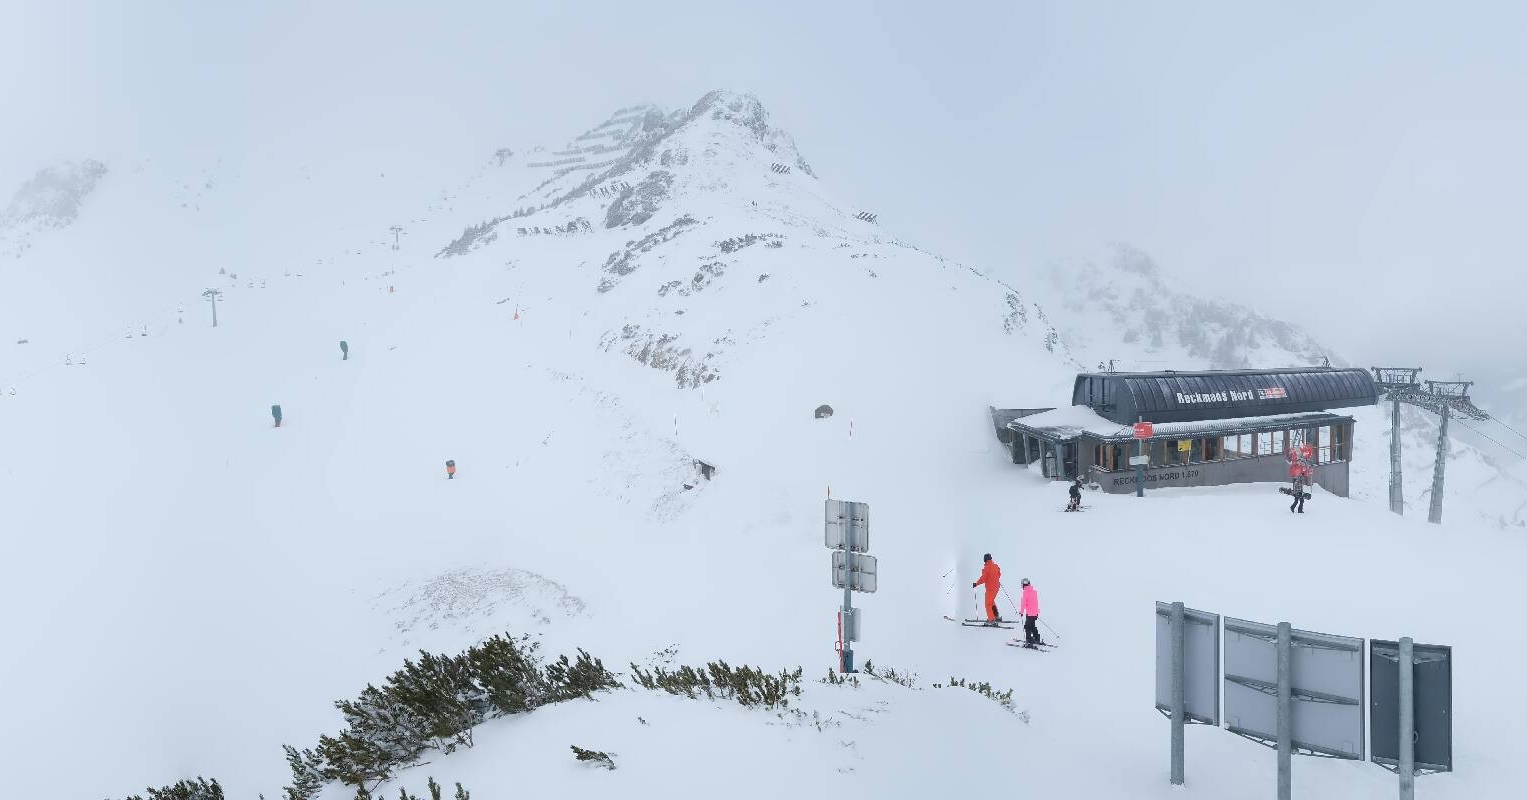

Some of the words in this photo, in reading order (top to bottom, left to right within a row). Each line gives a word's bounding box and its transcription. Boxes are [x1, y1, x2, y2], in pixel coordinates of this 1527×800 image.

[1176, 391, 1228, 404] Reckmoos
[1229, 389, 1255, 402] Nord
[1114, 474, 1157, 486] RECKOOS
[1159, 472, 1180, 481] NORD
